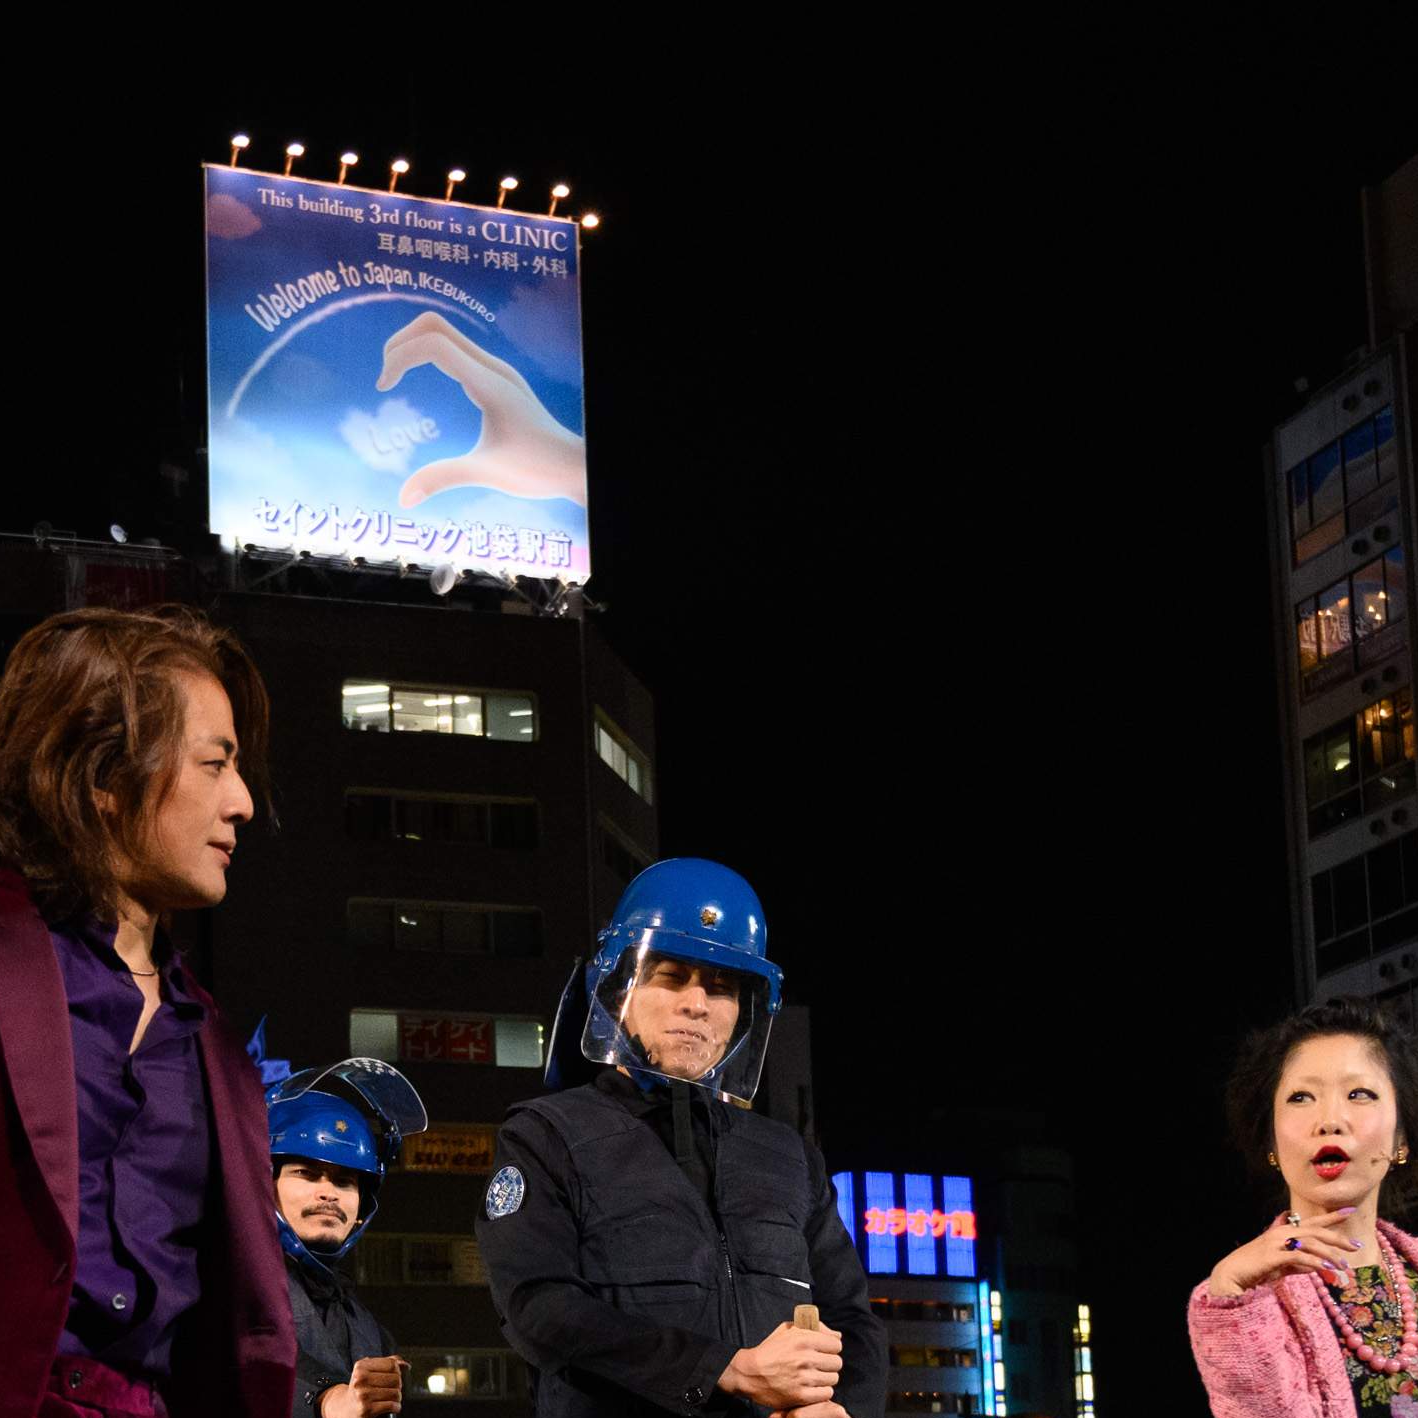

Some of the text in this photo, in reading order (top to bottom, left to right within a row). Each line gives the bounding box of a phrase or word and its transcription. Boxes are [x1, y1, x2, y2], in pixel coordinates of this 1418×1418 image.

[258, 188, 567, 252] This building 3rd floor is a CLINIC
[377, 232, 567, 279] 耳鼻咽喉科・内科・外科
[244, 261, 340, 333] Welcome
[339, 262, 361, 287] to
[369, 414, 441, 457] Love
[253, 496, 573, 568] セイントクリニック池袋駅前
